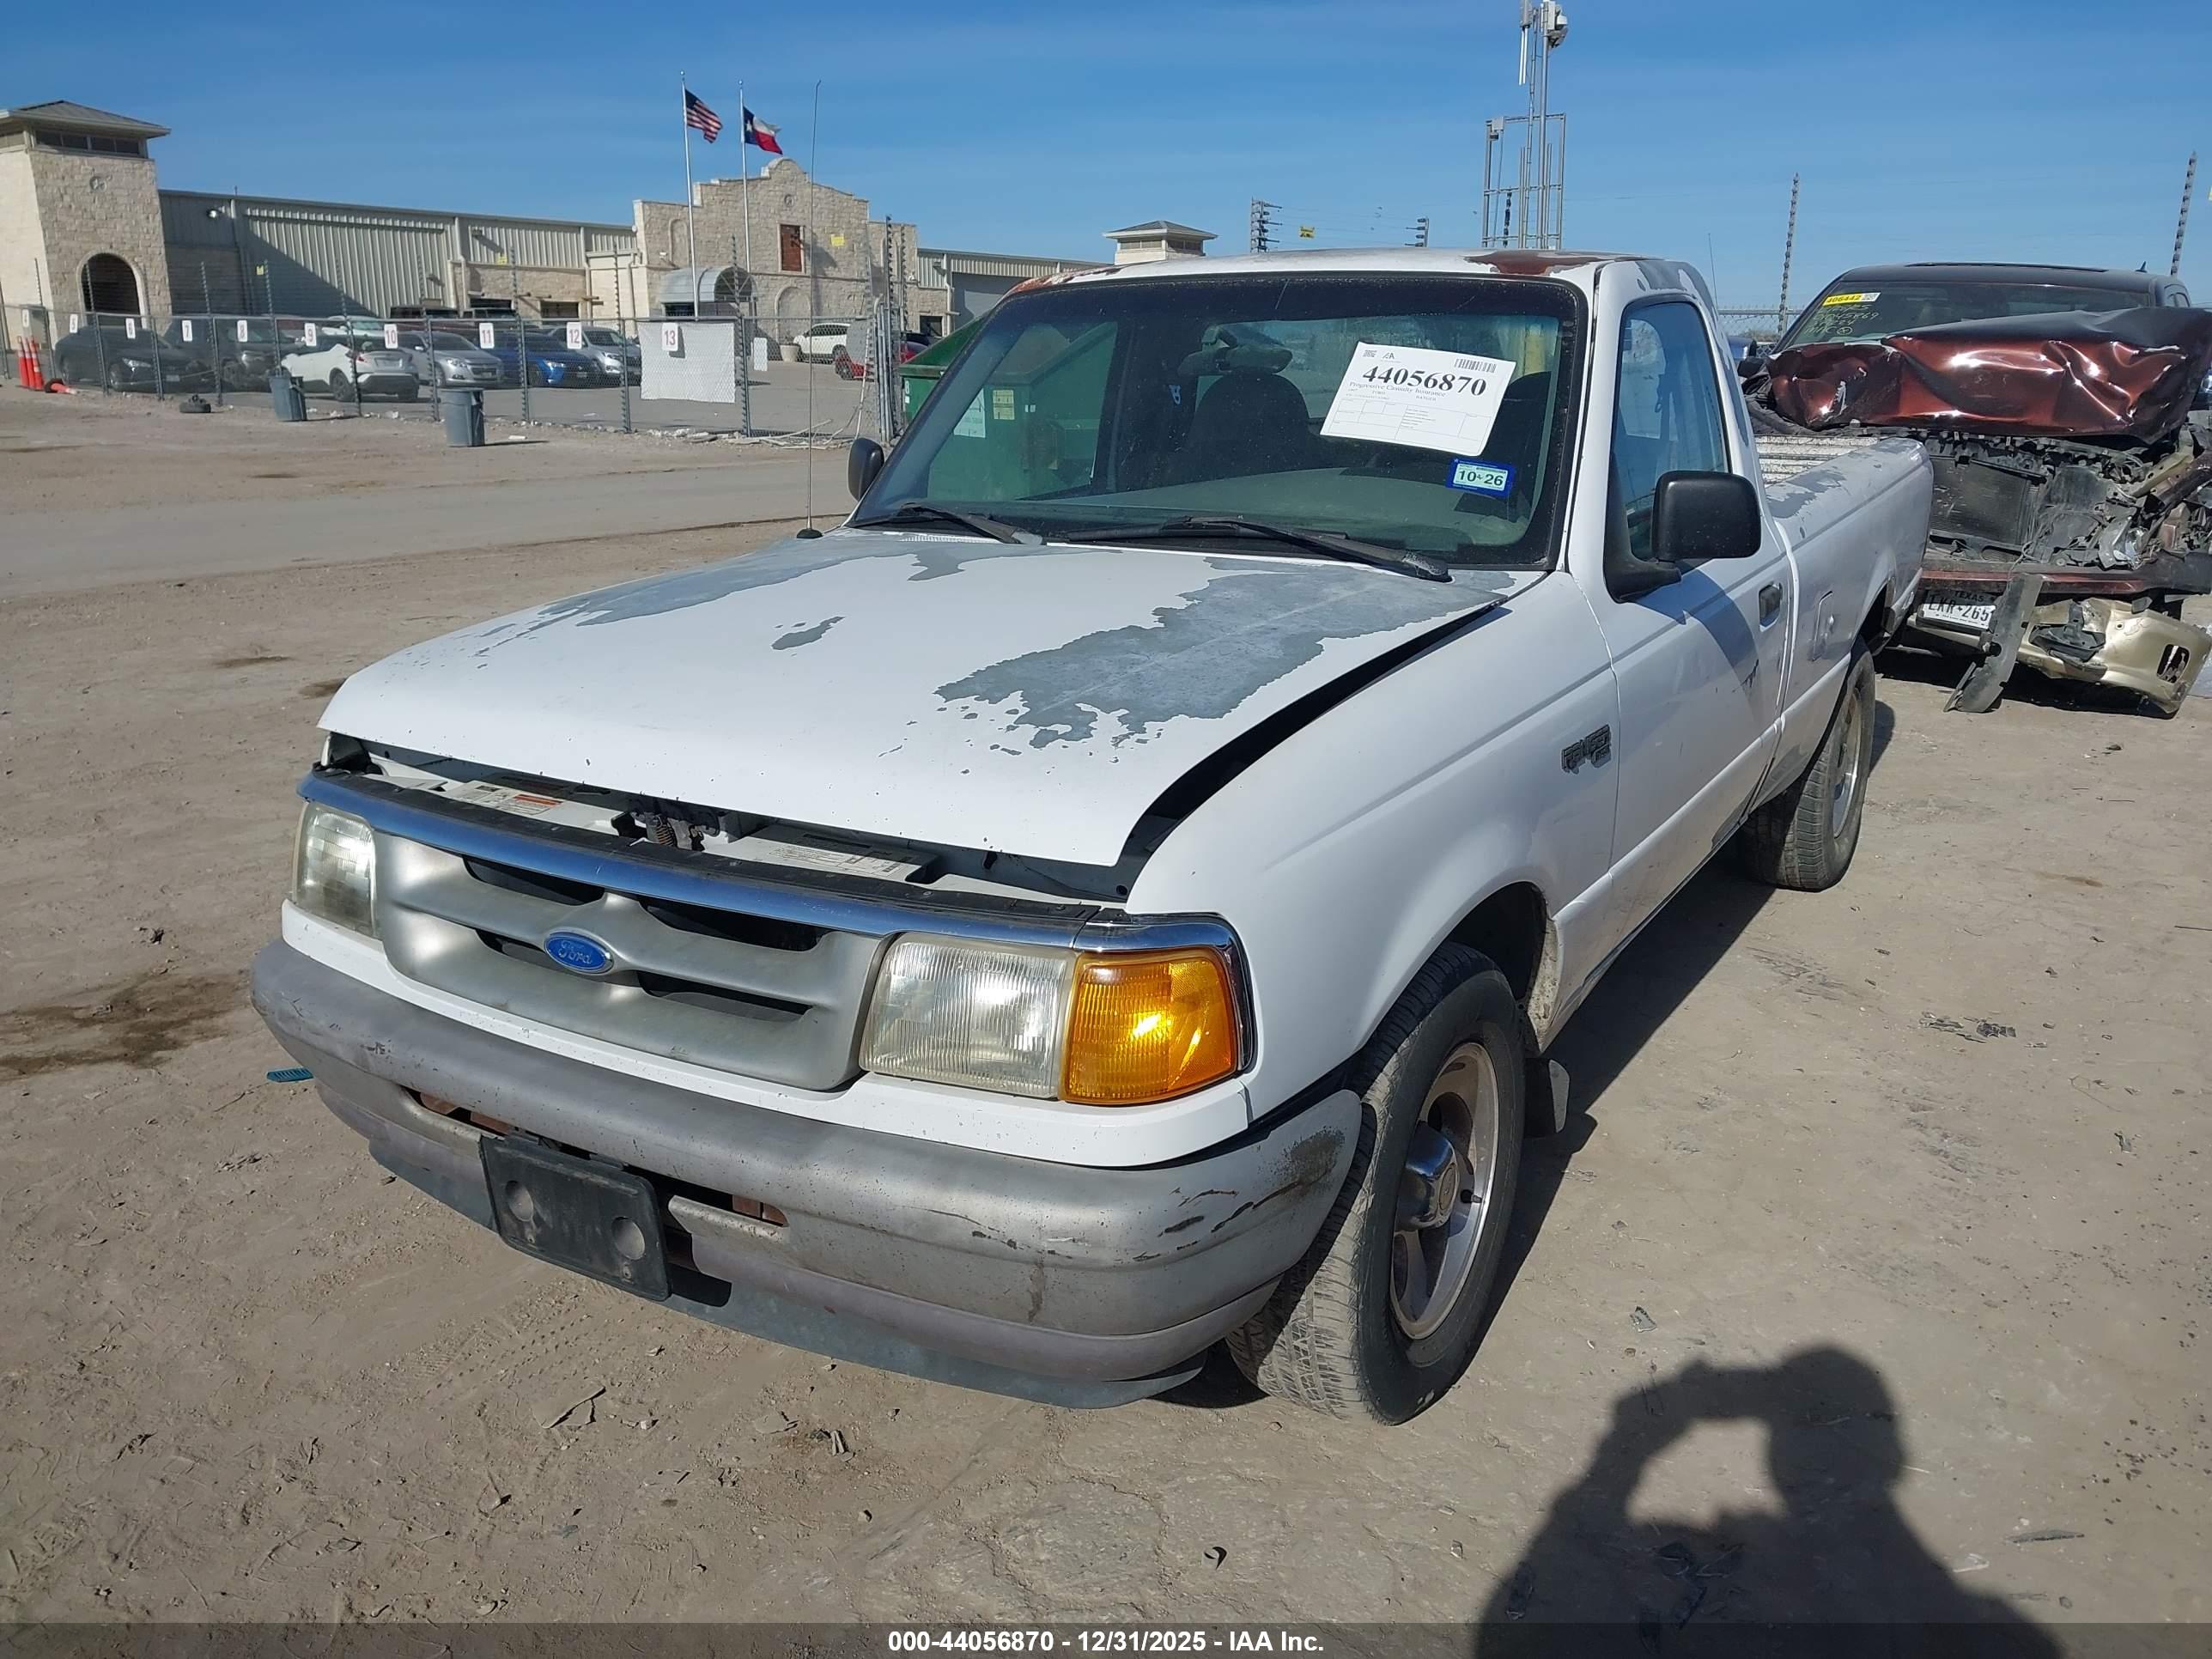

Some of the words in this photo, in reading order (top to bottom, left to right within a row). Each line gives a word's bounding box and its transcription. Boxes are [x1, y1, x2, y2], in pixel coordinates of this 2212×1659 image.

[184, 325, 190, 337] 7
[307, 328, 313, 342] 9
[386, 330, 397, 344] 10
[481, 329, 492, 344] 11
[568, 329, 580, 343] 12
[664, 330, 676, 345] 13
[1363, 365, 1487, 397] 44056870
[1386, 385, 1413, 393] Casualty
[1415, 388, 1447, 397] Insurance
[1954, 590, 1984, 602] TEXAS
[556, 939, 592, 964] Ford
